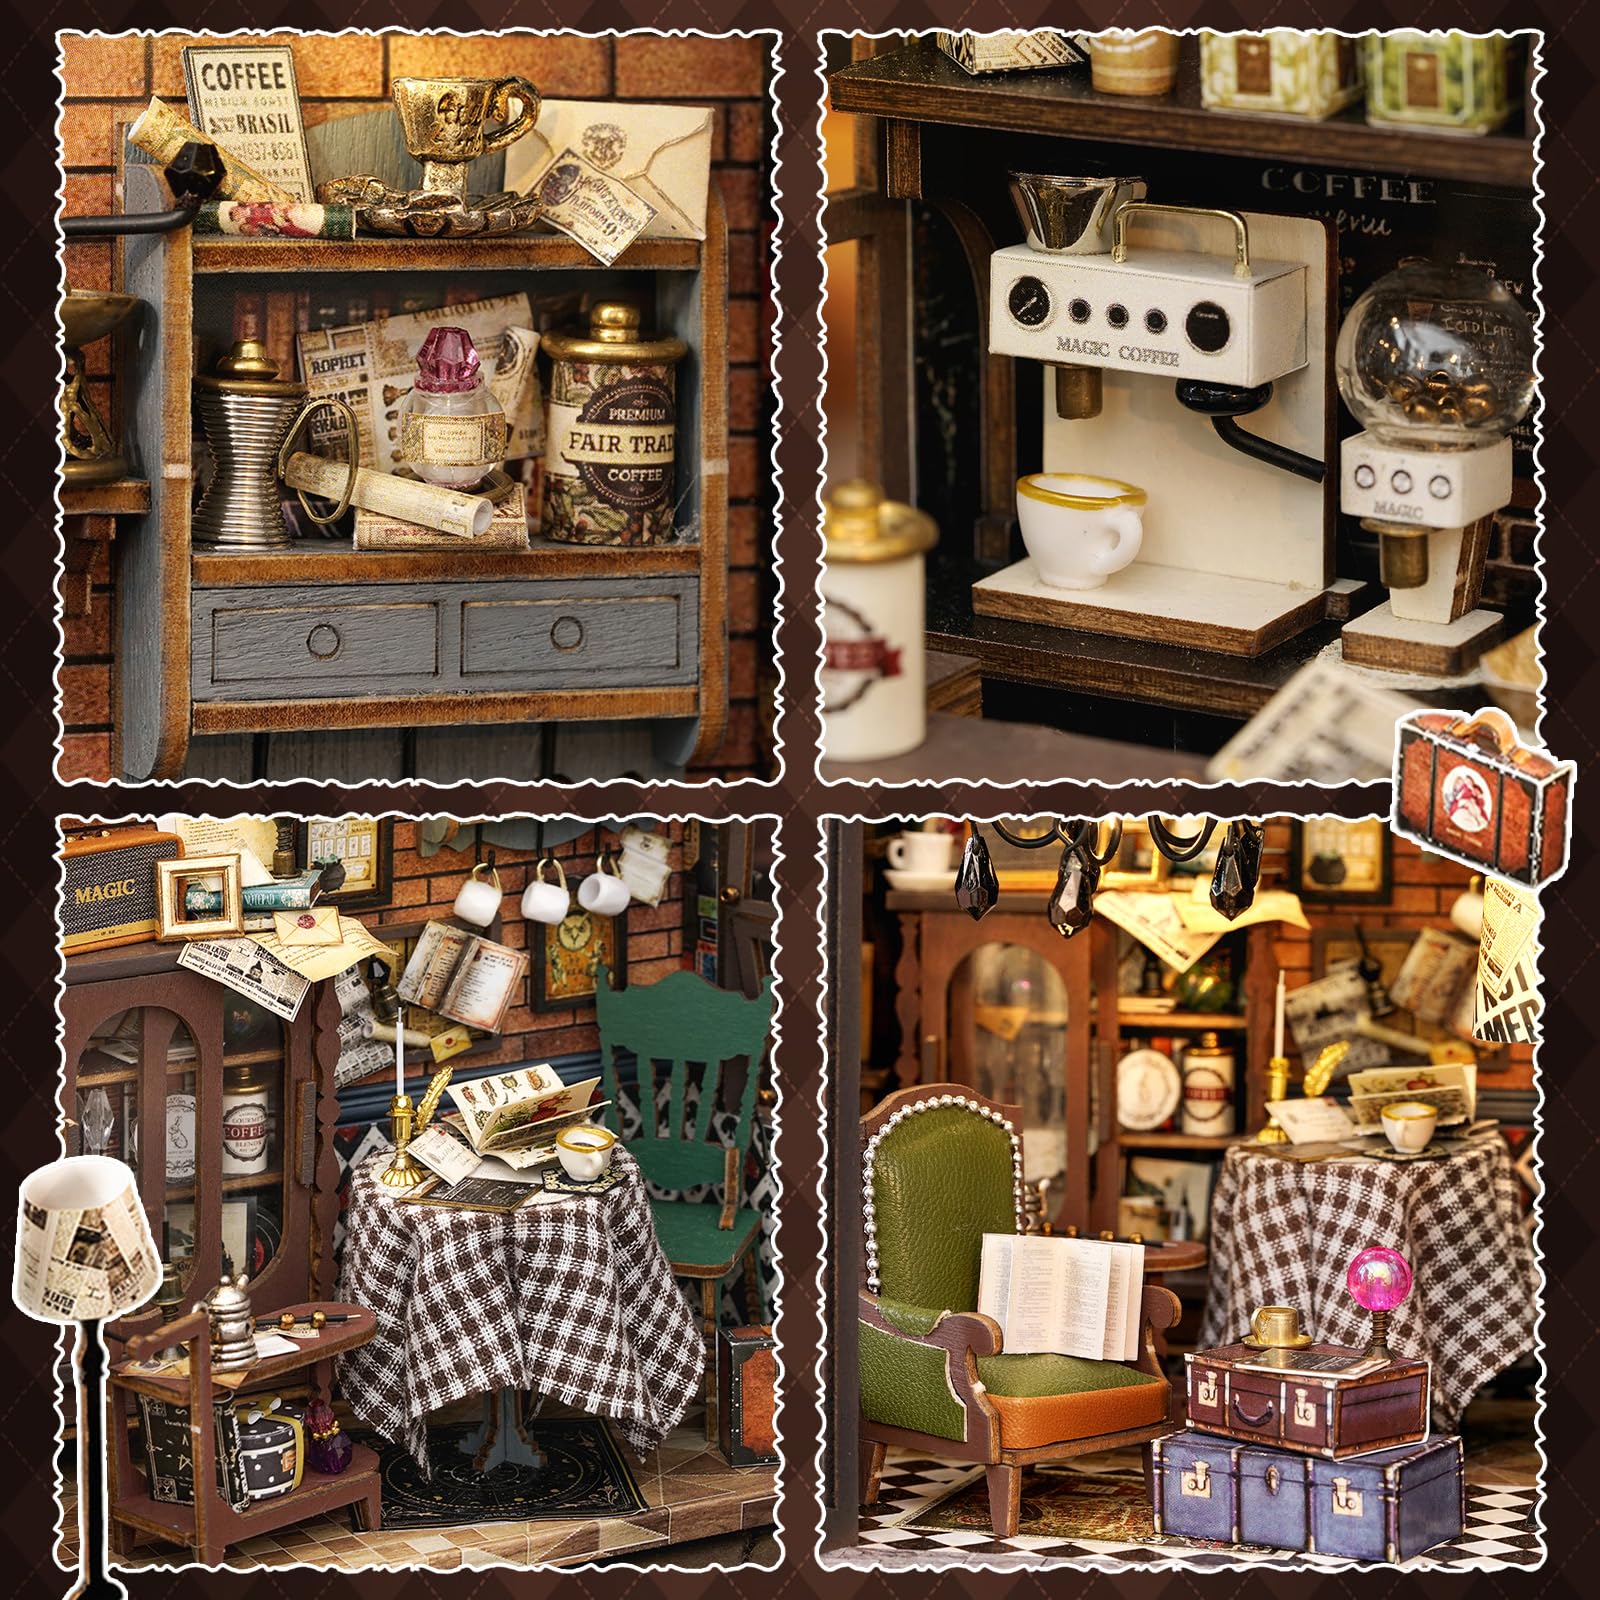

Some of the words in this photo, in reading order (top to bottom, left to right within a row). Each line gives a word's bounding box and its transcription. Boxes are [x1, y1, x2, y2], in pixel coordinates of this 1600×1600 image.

[201, 62, 287, 91] COFFEE
[236, 113, 294, 135] BRASIL
[1261, 166, 1437, 204] COFFEE
[1310, 208, 1392, 237] enu
[1056, 335, 1111, 358] MAGIC
[1118, 344, 1181, 368] COFFEE
[608, 408, 666, 421] PREMIUM
[569, 431, 621, 453] FAIR
[607, 469, 663, 482] COFFEE
[1372, 500, 1424, 521] MAGIC
[74, 879, 136, 905] MAGIC
